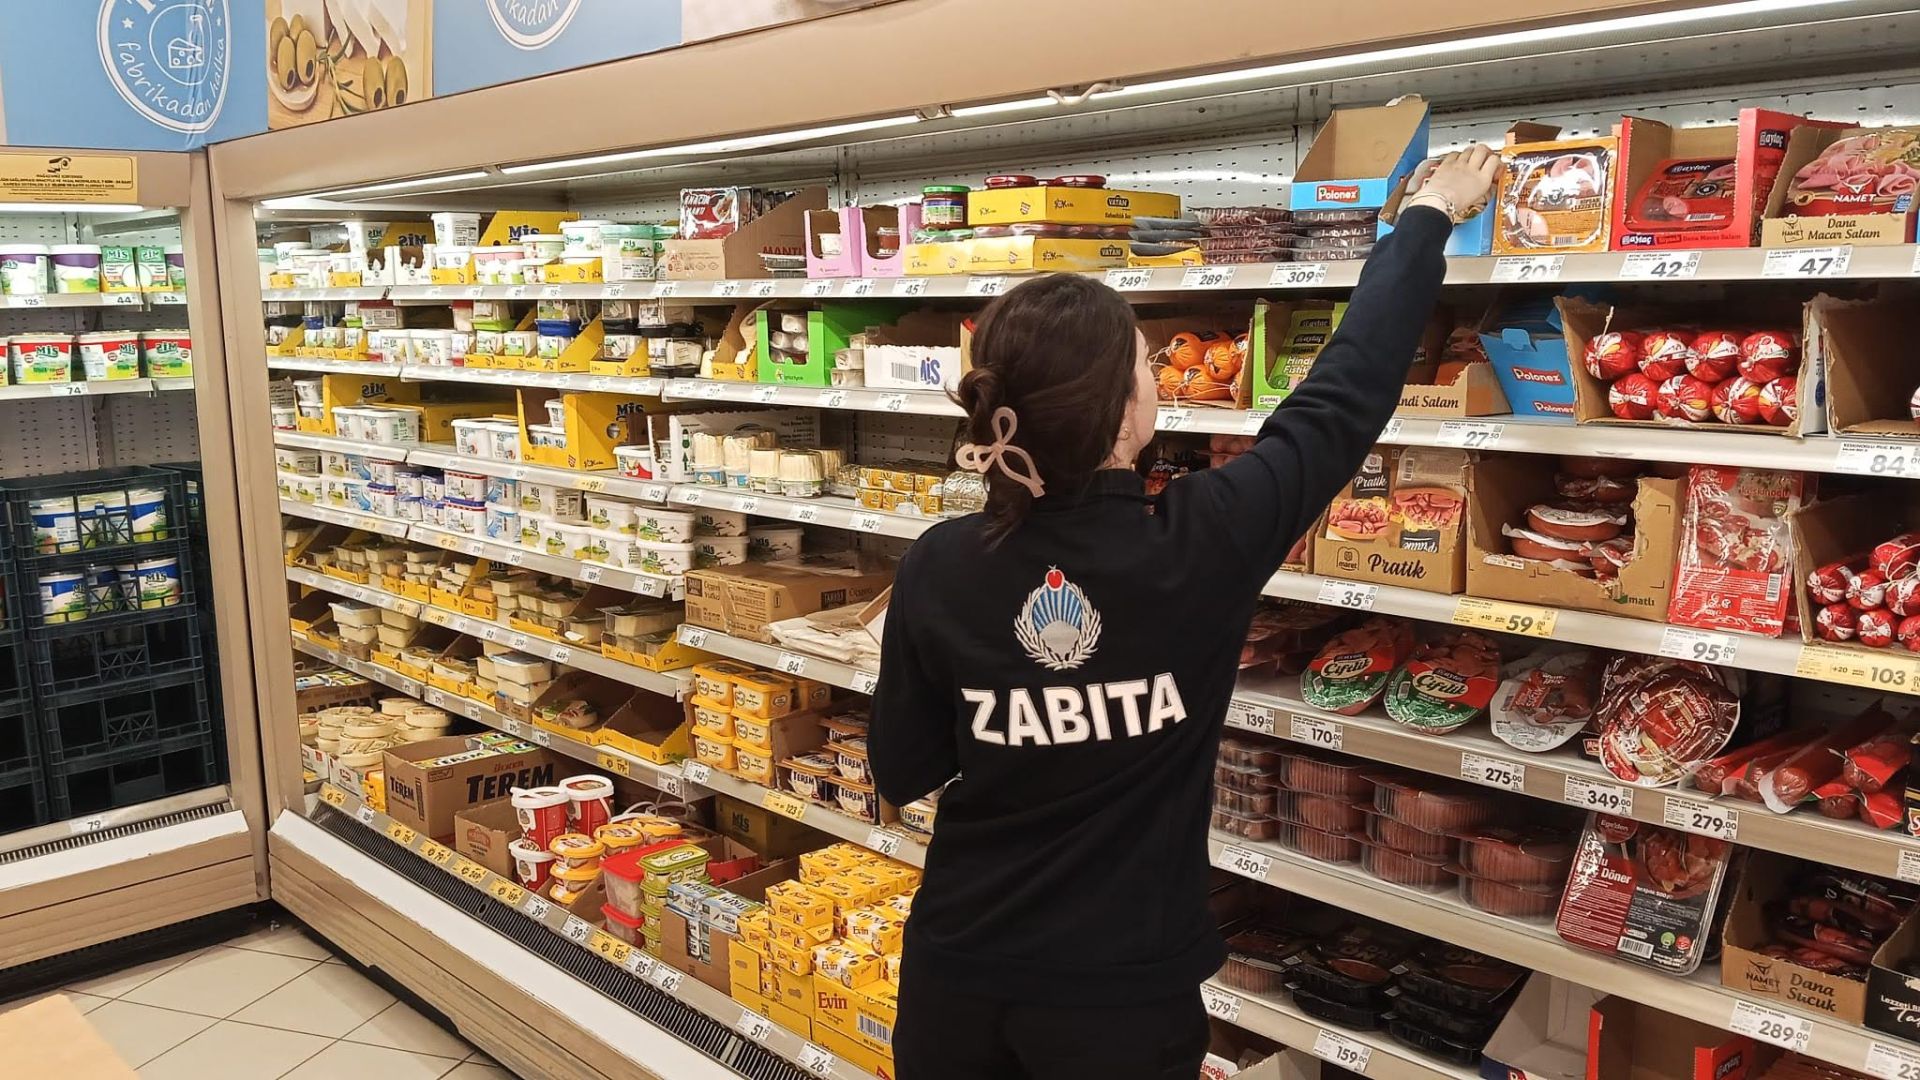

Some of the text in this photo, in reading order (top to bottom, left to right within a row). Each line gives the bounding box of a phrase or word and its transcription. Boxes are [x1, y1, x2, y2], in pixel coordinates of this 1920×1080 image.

[117, 37, 226, 118] fabrikadan halka
[1317, 188, 1359, 201] Polonez
[1833, 194, 1876, 203] NAMET
[1107, 198, 1128, 207] VATAN
[1827, 218, 1857, 229] Dana
[1808, 228, 1881, 241] Macar Salam
[1100, 248, 1123, 257] VATAN
[1119, 277, 1141, 287] 249
[1199, 274, 1222, 286] 289
[1287, 271, 1314, 283] 309
[855, 285, 868, 295] 41
[905, 284, 919, 295] 45
[980, 283, 996, 295] 45
[1513, 367, 1561, 383] Polonez
[888, 400, 901, 411] 43
[1423, 395, 1459, 409] Salam
[1165, 416, 1181, 430] 97
[1870, 454, 1905, 474] 84
[1354, 475, 1388, 488] Pratik
[1368, 553, 1427, 579] Pratik
[1507, 614, 1534, 632] 59
[787, 661, 799, 672] 84
[1323, 657, 1371, 675] Çiftlik
[1871, 666, 1906, 686] 103
[1416, 675, 1468, 696] Çiftlik
[961, 672, 1188, 747] ZABITA
[390, 776, 415, 800] TEREM
[466, 763, 554, 804] TEREM
[667, 783, 676, 793] 45
[88, 820, 101, 829] 79
[879, 840, 892, 853] 76
[1601, 868, 1632, 885] Döner
[532, 905, 543, 917] 39
[571, 926, 583, 939] 39
[853, 926, 869, 936] Evin
[635, 963, 647, 975] 85
[821, 961, 838, 971] Evin
[662, 976, 675, 989] 62
[1745, 971, 1780, 989] NAMET
[1790, 973, 1836, 997] Dana
[818, 992, 848, 1010] Evin
[1786, 987, 1837, 1013] Sucuk
[810, 1056, 825, 1072] 26
